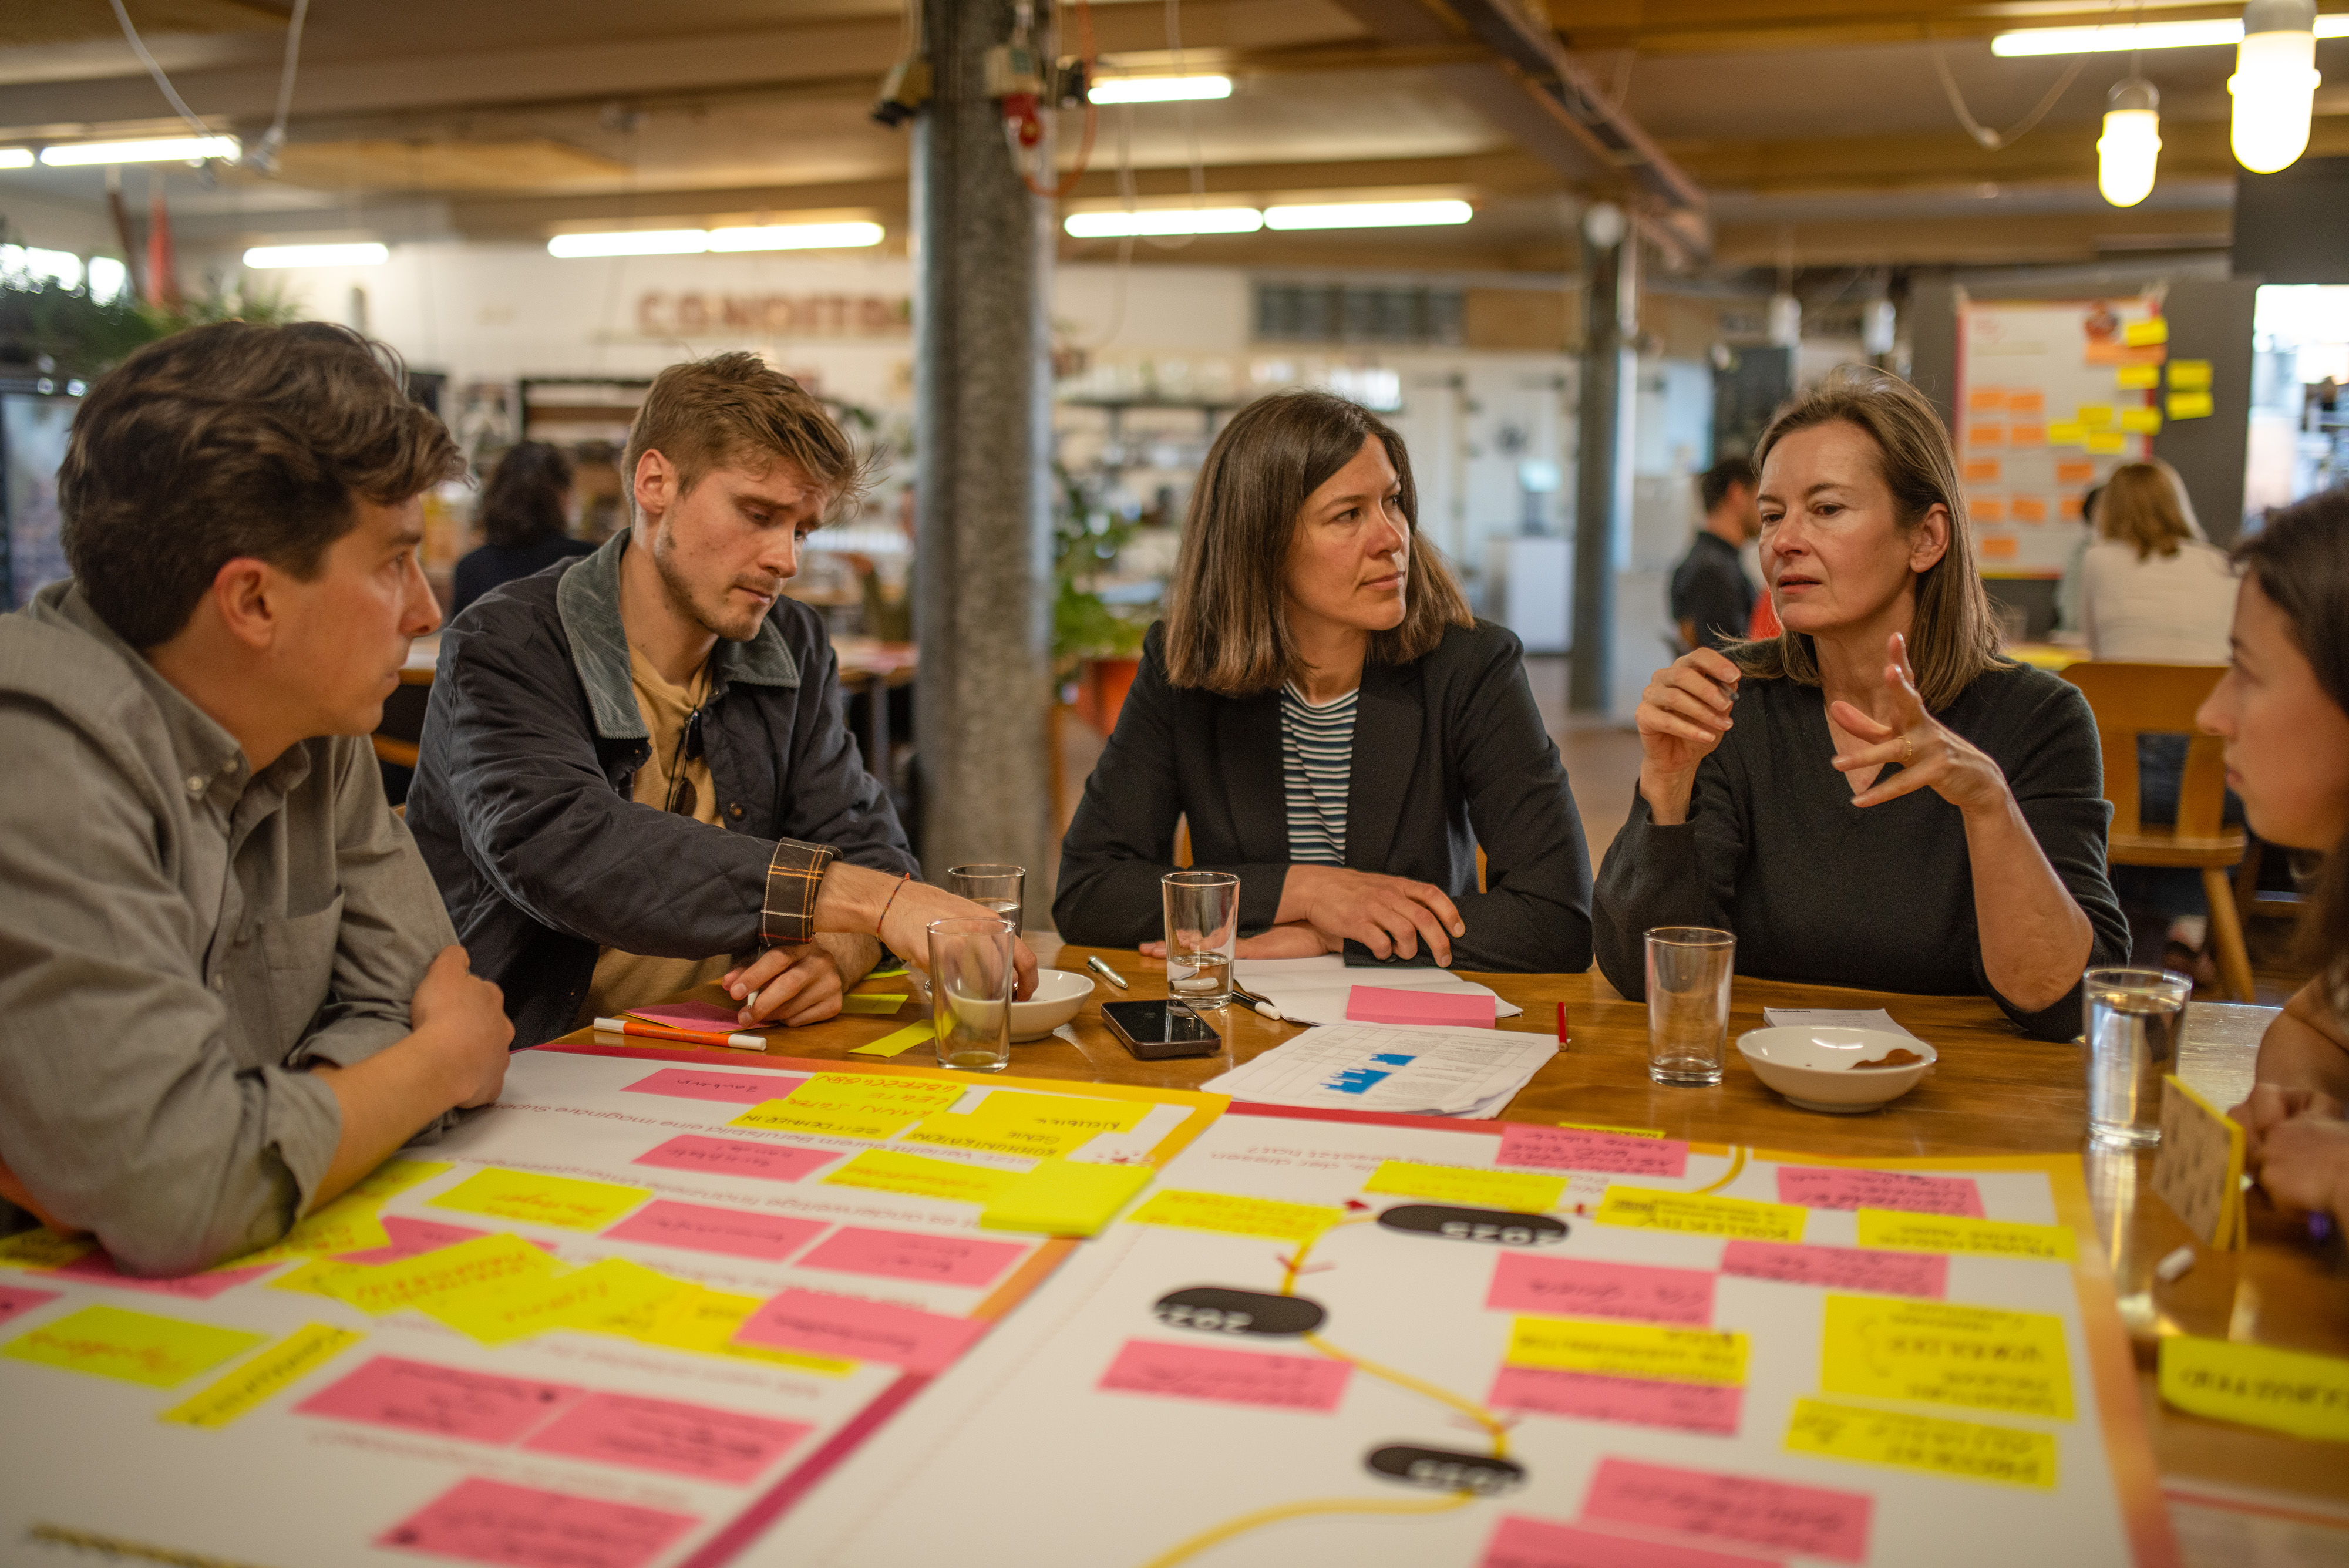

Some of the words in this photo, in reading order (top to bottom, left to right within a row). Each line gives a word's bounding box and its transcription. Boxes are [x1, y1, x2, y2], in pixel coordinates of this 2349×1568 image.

[555, 1107, 658, 1126] imaginäre
[659, 1121, 704, 1130] eine
[706, 1126, 815, 1144] Berufsbild
[1004, 1132, 1062, 1145] GENIE
[1245, 1147, 1303, 1158] hat?
[1210, 1153, 1291, 1166] diesen
[1441, 1220, 1560, 1247] 2025
